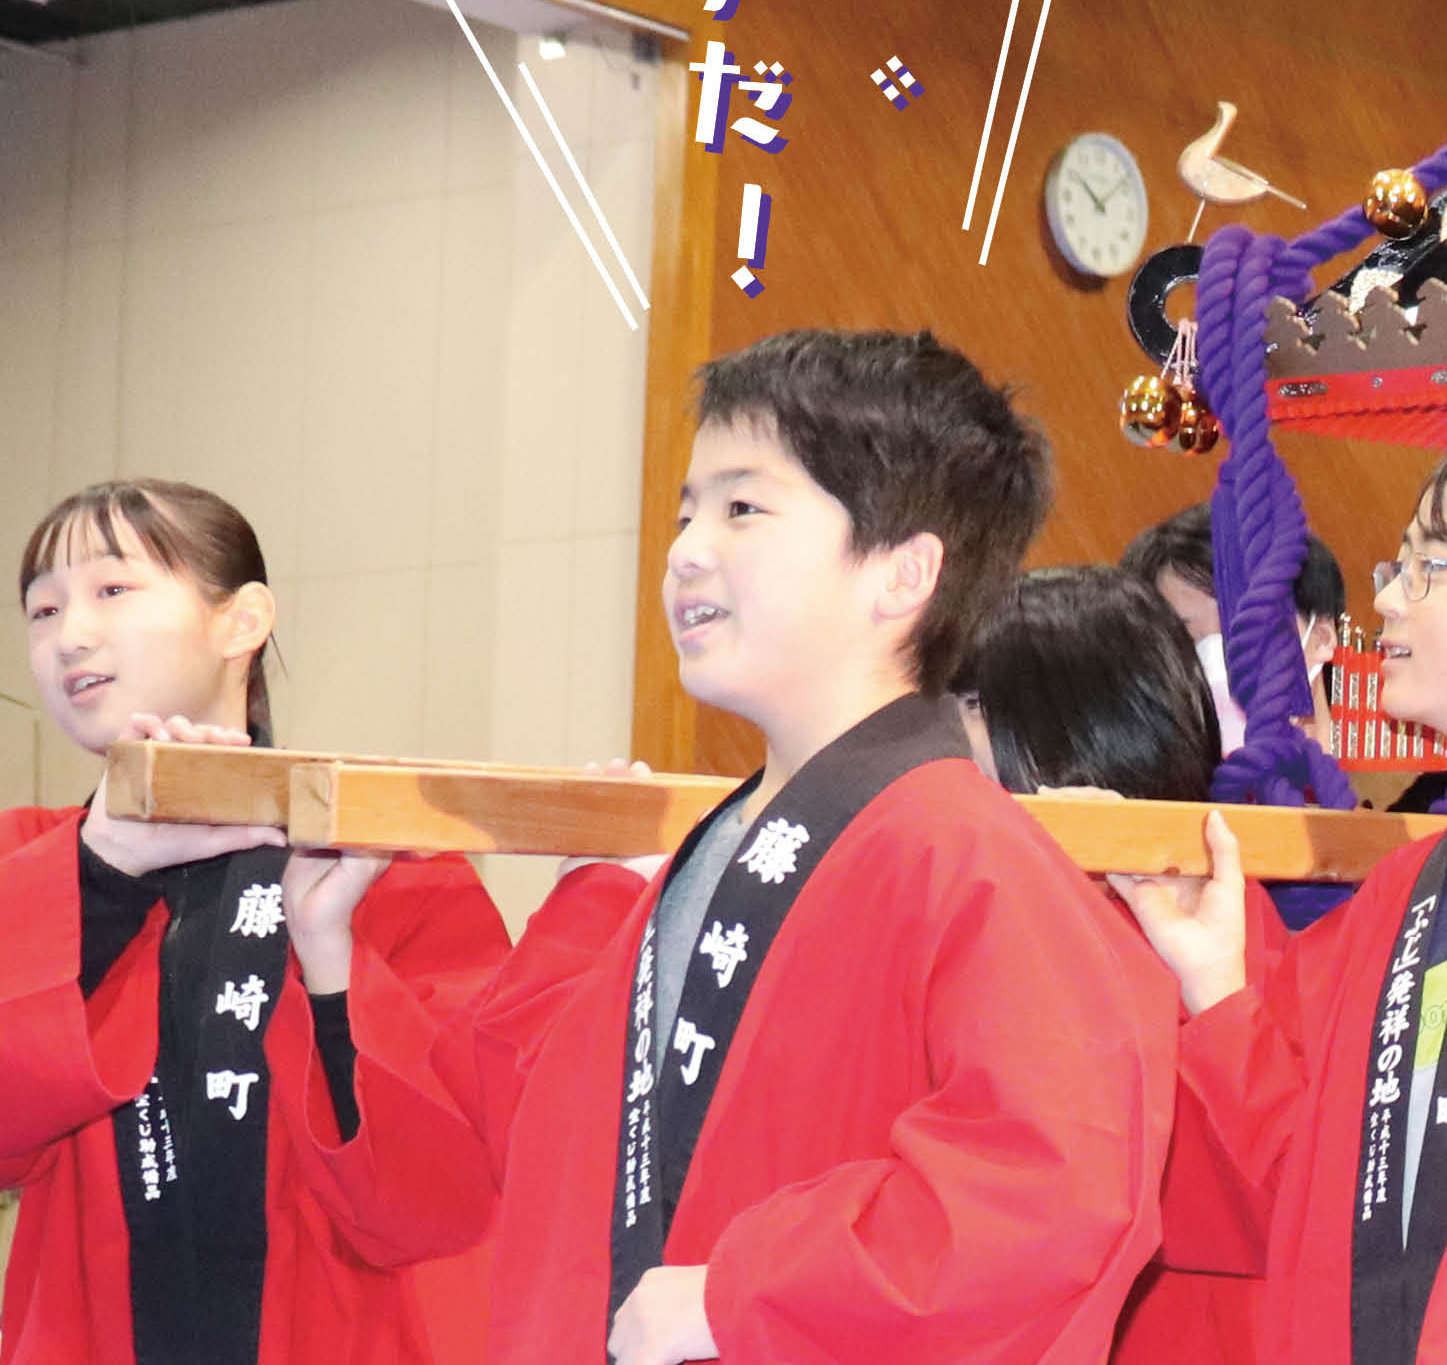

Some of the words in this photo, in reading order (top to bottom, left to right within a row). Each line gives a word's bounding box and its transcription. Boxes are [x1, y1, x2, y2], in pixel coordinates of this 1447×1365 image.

[207, 883, 287, 1120] 藤崎町
[673, 818, 810, 1085] 藤崎町
